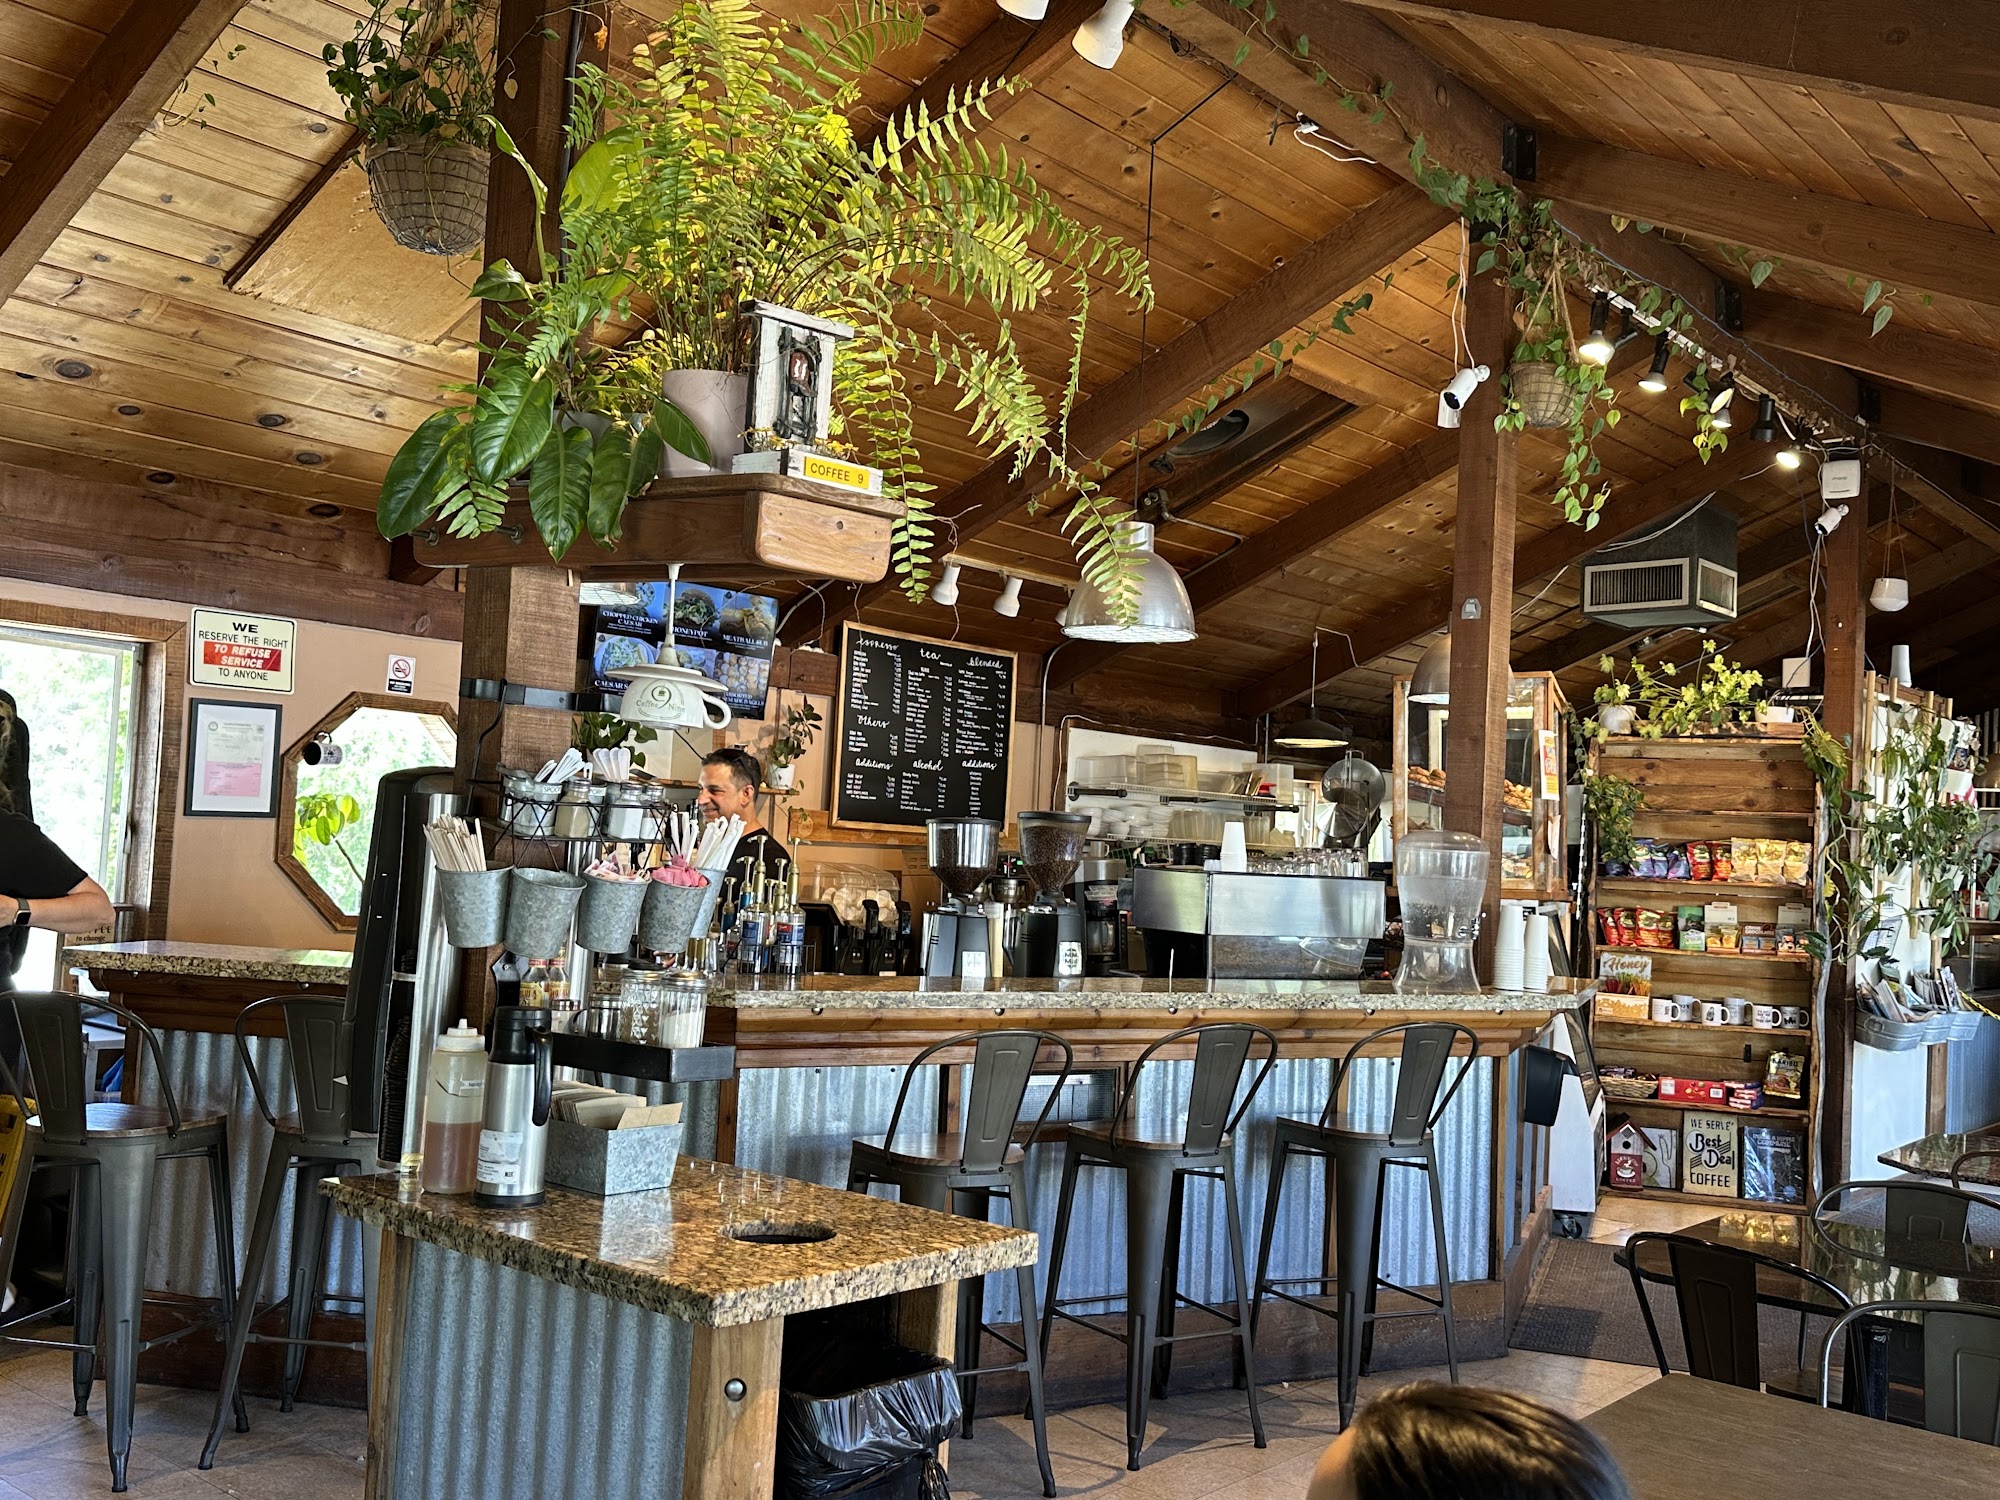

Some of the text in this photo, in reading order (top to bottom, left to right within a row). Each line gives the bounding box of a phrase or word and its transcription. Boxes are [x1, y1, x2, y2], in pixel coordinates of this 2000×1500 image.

[810, 462, 864, 484] COFFEE 9
[232, 622, 259, 633] WE
[618, 618, 643, 627] CAESAR
[199, 630, 288, 648] RESERVE THE RIGHT
[722, 633, 755, 645] MEATBALL
[856, 638, 899, 650] espresso
[214, 643, 271, 658] TO REFUSE
[919, 648, 942, 660] tea
[221, 656, 263, 668] SERVICE
[966, 656, 1003, 669] blended
[218, 667, 268, 680] TO ANYONE
[594, 679, 624, 690] CAESAR
[636, 699, 685, 712] Coffee Nine
[912, 758, 944, 771] alcohol
[961, 759, 998, 771] additions
[1603, 956, 1650, 974] Honey
[1690, 1118, 1702, 1129] WE
[1689, 1132, 1722, 1153] Best
[1704, 1148, 1735, 1171] Deal
[1690, 1172, 1731, 1188] COFFEE
